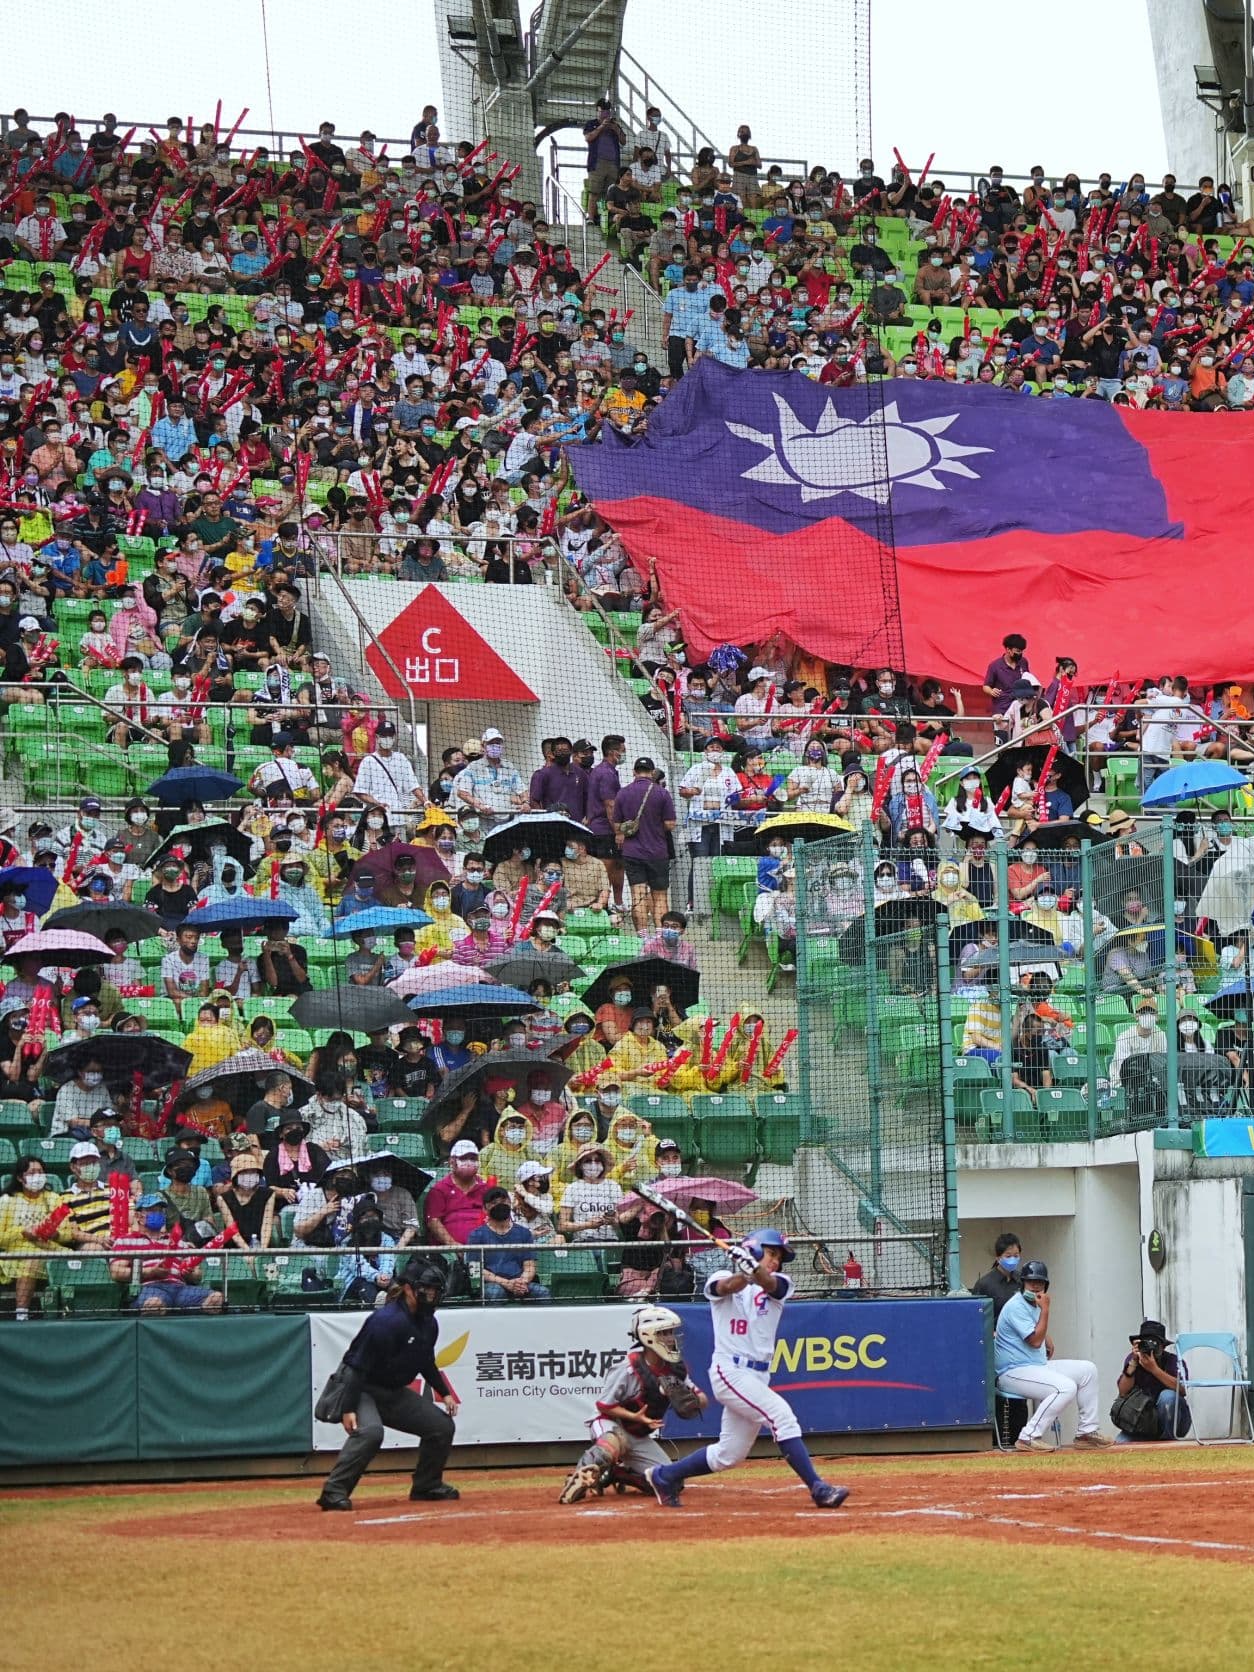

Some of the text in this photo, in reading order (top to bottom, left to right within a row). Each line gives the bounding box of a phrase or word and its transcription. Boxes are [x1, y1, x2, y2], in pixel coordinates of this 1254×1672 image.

[421, 627, 442, 654] C
[405, 656, 460, 683] 出口
[730, 1318, 748, 1335] 18
[769, 1334, 887, 1373] WBSC
[477, 1386, 519, 1398] Tainan
[522, 1385, 546, 1399] City
